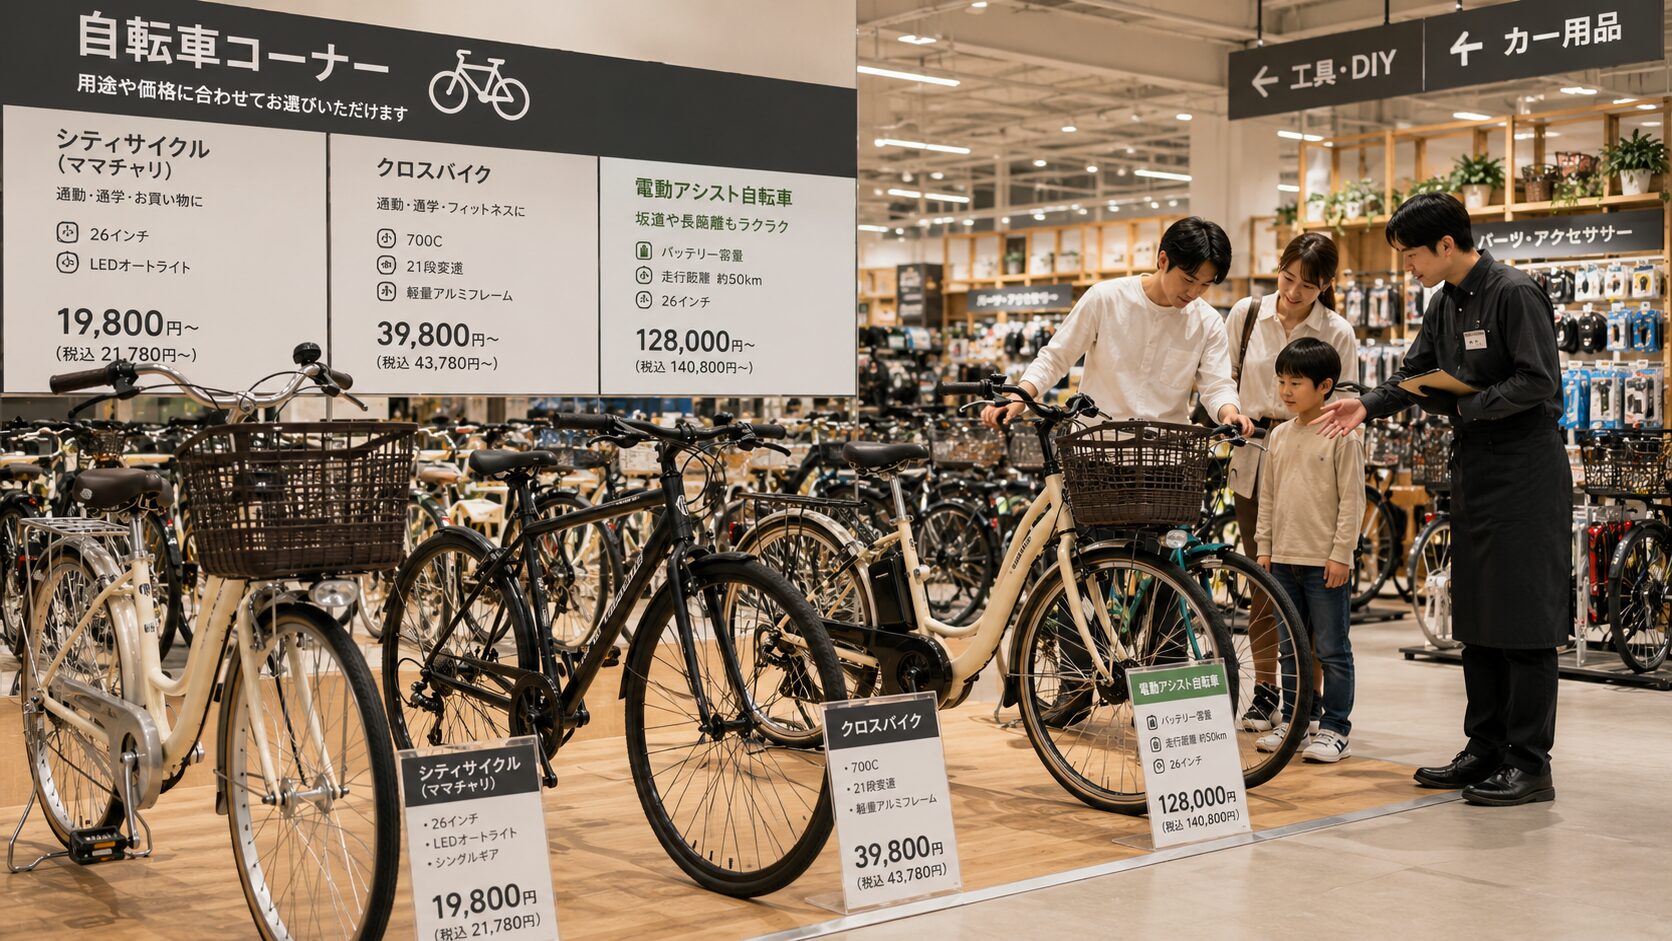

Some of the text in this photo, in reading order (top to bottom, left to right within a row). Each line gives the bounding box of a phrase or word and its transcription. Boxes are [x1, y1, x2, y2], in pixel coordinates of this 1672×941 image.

[78, 9, 390, 82] 自転車コーナー
[1504, 11, 1622, 56] カー用品
[1290, 49, 1397, 89] 工具・DIY
[76, 72, 409, 123] 用途や価格に合わせてお選びいただけます
[56, 128, 211, 159] シティサイクル
[57, 154, 172, 181] (ママチャリ)
[376, 157, 492, 184] クロスバイク
[634, 177, 794, 208] 電動アシスト自転車
[90, 227, 150, 243] 26インチ
[406, 233, 443, 248] 700C
[90, 257, 191, 275] LEDオートライト
[406, 285, 514, 302] 軽量アルミフレーム
[661, 294, 711, 309] 26インチ
[56, 346, 96, 362] (税込
[376, 354, 410, 370] (税込
[635, 359, 666, 374] (税込
[841, 713, 922, 738] クロスバイク
[419, 756, 522, 781] シティサイクル
[851, 759, 879, 773] 700C
[1169, 755, 1203, 770] 26インチ
[421, 776, 496, 799] (ママチャリ)
[1158, 785, 1237, 815] 128,000円
[431, 812, 479, 830] 26インチ
[1186, 808, 1240, 829] 140,800円)
[433, 826, 518, 850] LEDオートライト
[435, 848, 499, 869] シングルギア
[854, 835, 944, 869] 39,800円
[857, 862, 947, 891] (税込 43,780円)
[432, 883, 538, 920] 19,800円
[471, 911, 541, 937] 21,780円)
